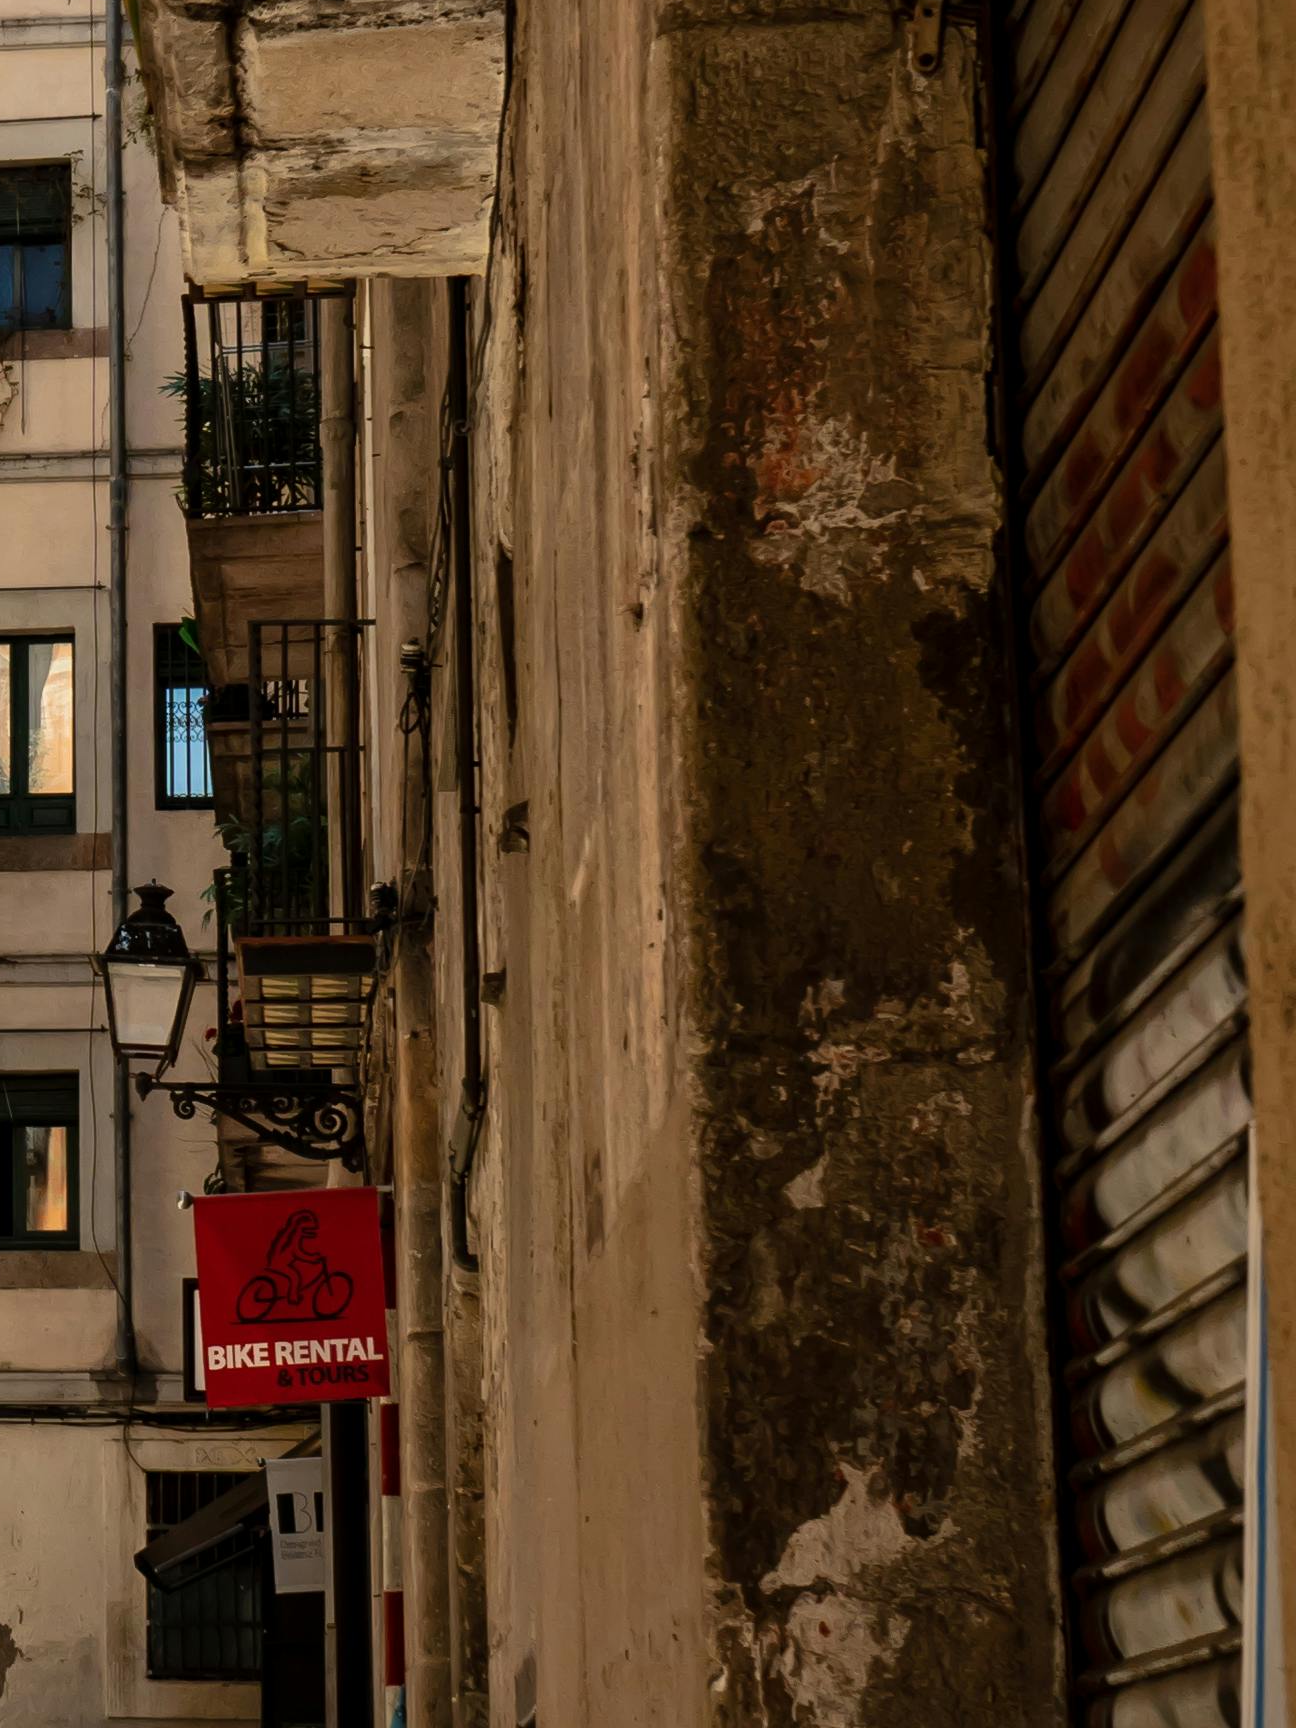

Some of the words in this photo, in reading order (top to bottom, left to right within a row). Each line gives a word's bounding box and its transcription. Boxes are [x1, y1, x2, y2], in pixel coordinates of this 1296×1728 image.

[208, 1342, 270, 1371] BIKE
[274, 1336, 383, 1366] RENTAL
[278, 1371, 292, 1387] &
[298, 1365, 369, 1385] TOURS
